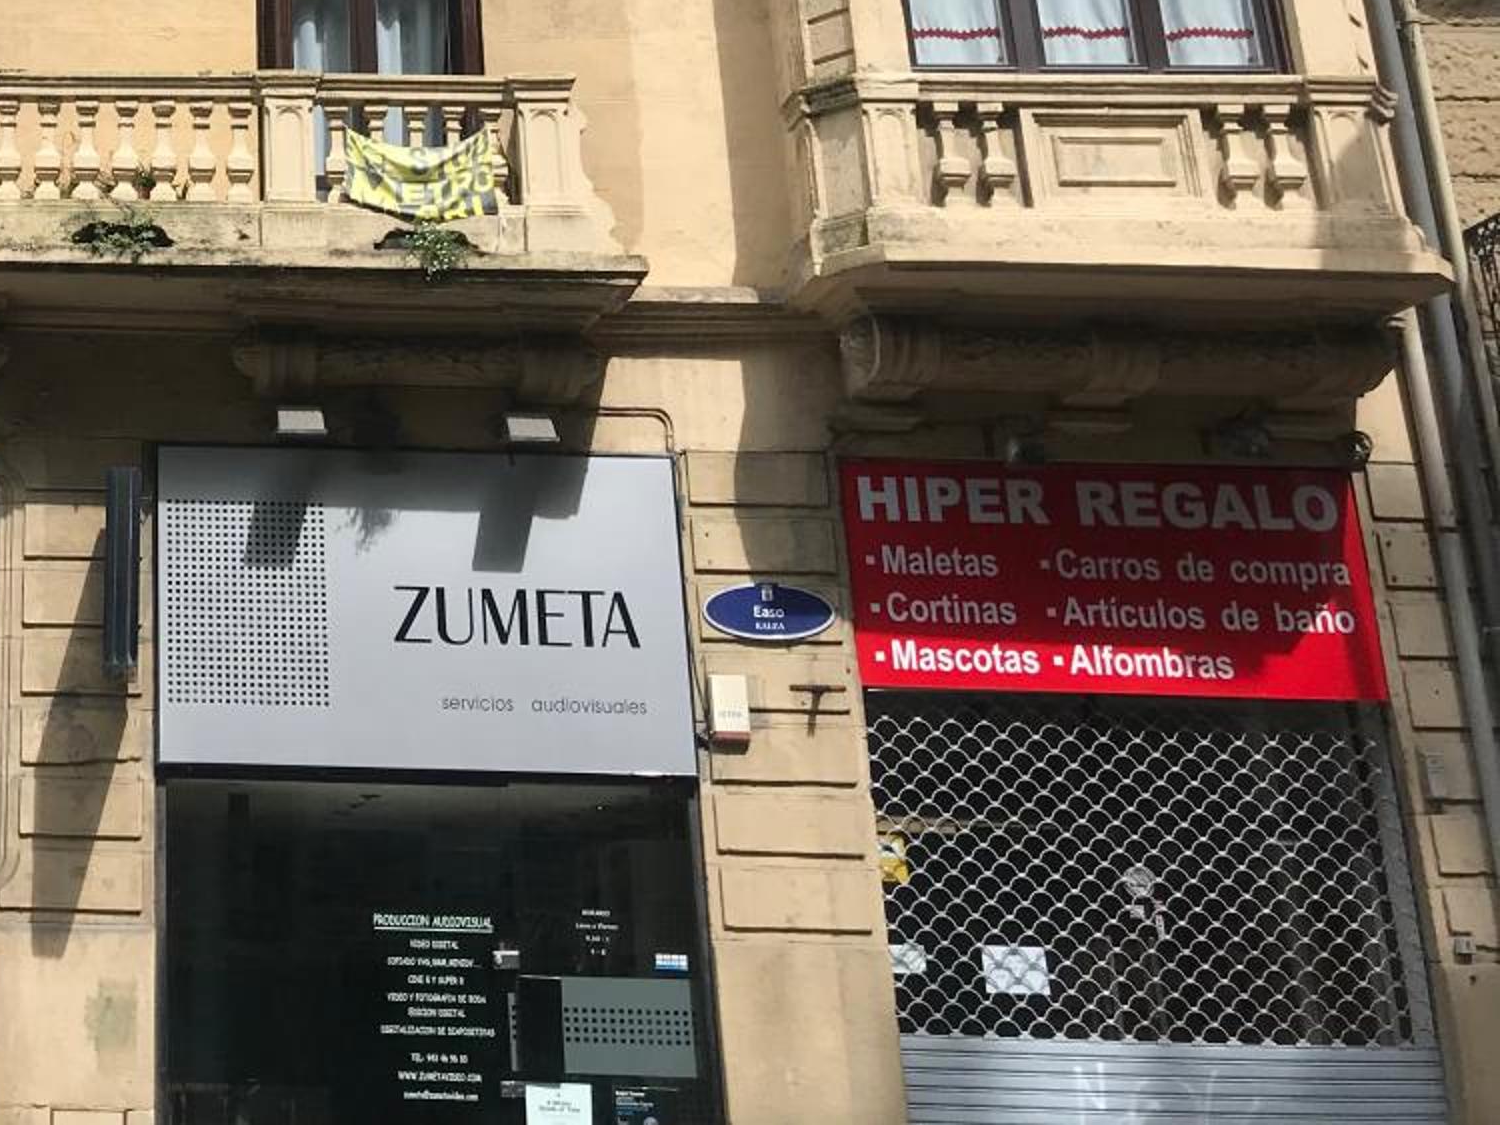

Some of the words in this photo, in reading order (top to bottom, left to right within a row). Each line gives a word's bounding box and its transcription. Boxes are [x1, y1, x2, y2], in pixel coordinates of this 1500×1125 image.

[857, 475, 1051, 526] HIPER
[1076, 481, 1339, 532] REGALO
[881, 546, 998, 576] Maletas
[1056, 549, 1161, 580] Carros
[1176, 551, 1215, 581] de
[1231, 559, 1351, 591] compra
[393, 586, 641, 649] ZUMETA
[753, 605, 785, 618] Easo
[886, 593, 1017, 625] Cortinas
[1222, 600, 1260, 631] de
[1275, 603, 1355, 635] baño
[891, 640, 1040, 674] Mascotas
[1070, 645, 1235, 680] Alfombras
[441, 696, 515, 713] servicios
[531, 697, 648, 715] audiovisuales
[373, 913, 429, 927] PRODUCCION
